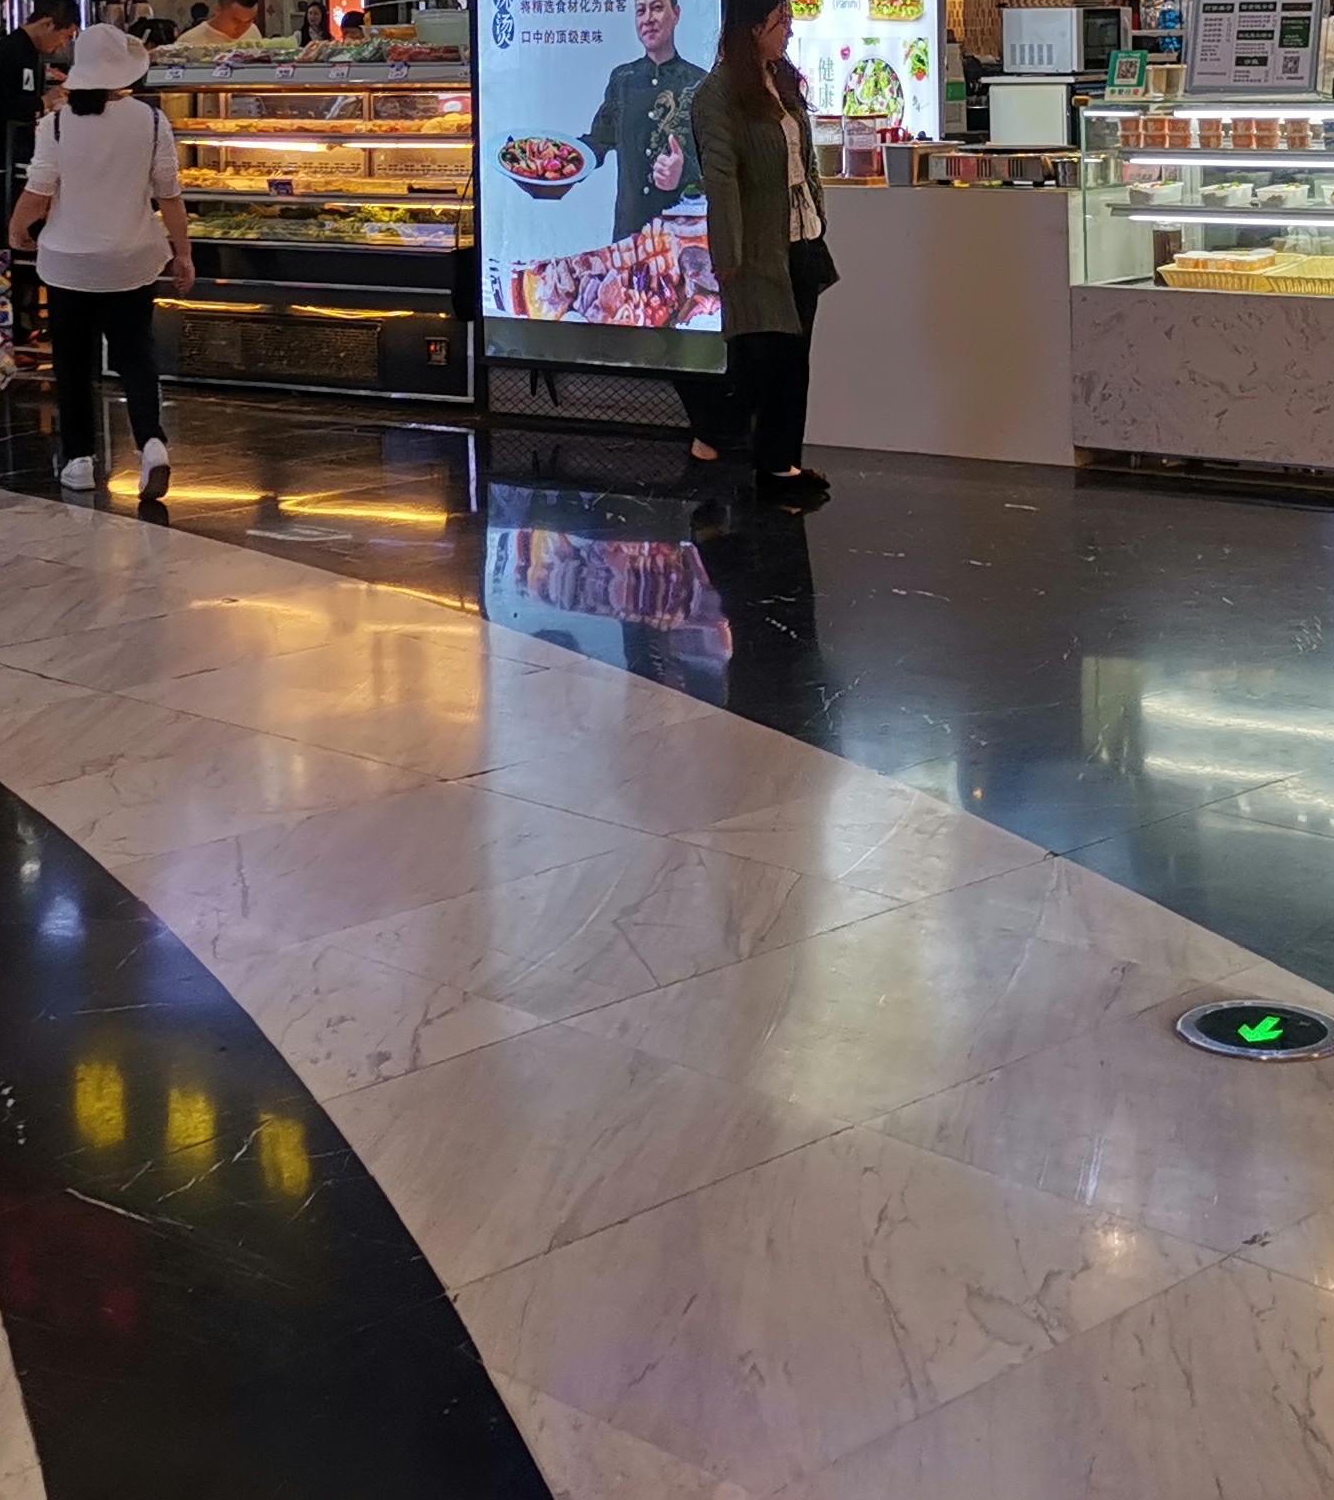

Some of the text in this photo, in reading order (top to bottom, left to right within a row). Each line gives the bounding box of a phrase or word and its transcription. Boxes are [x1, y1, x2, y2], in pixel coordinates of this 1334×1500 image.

[521, 30, 604, 45] 口中的顶级美味
